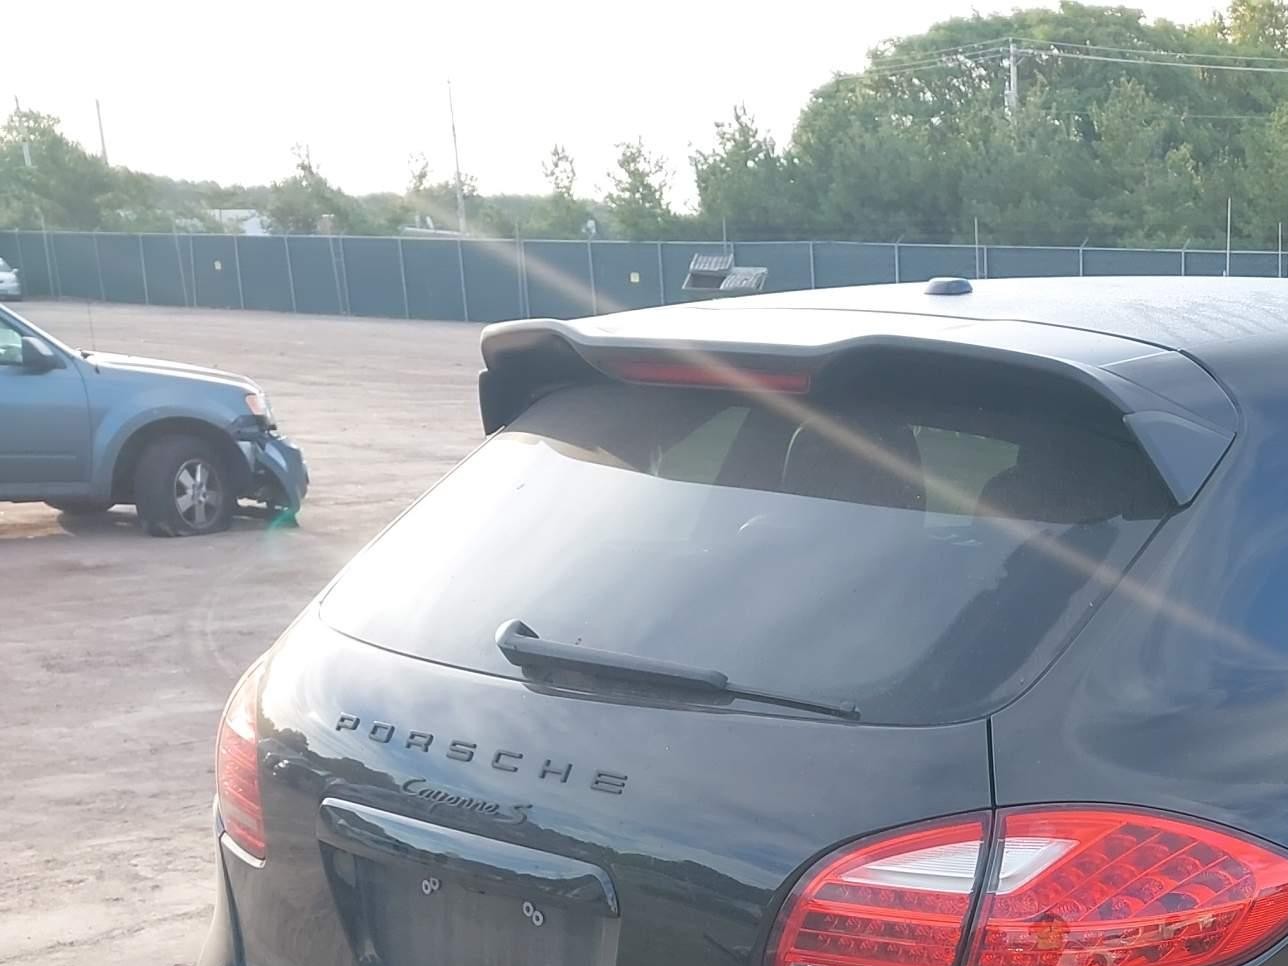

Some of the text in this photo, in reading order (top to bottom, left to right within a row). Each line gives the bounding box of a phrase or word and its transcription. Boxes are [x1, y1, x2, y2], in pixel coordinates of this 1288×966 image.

[335, 712, 628, 796] PORSCHE
[402, 779, 533, 825] Cayenne S
